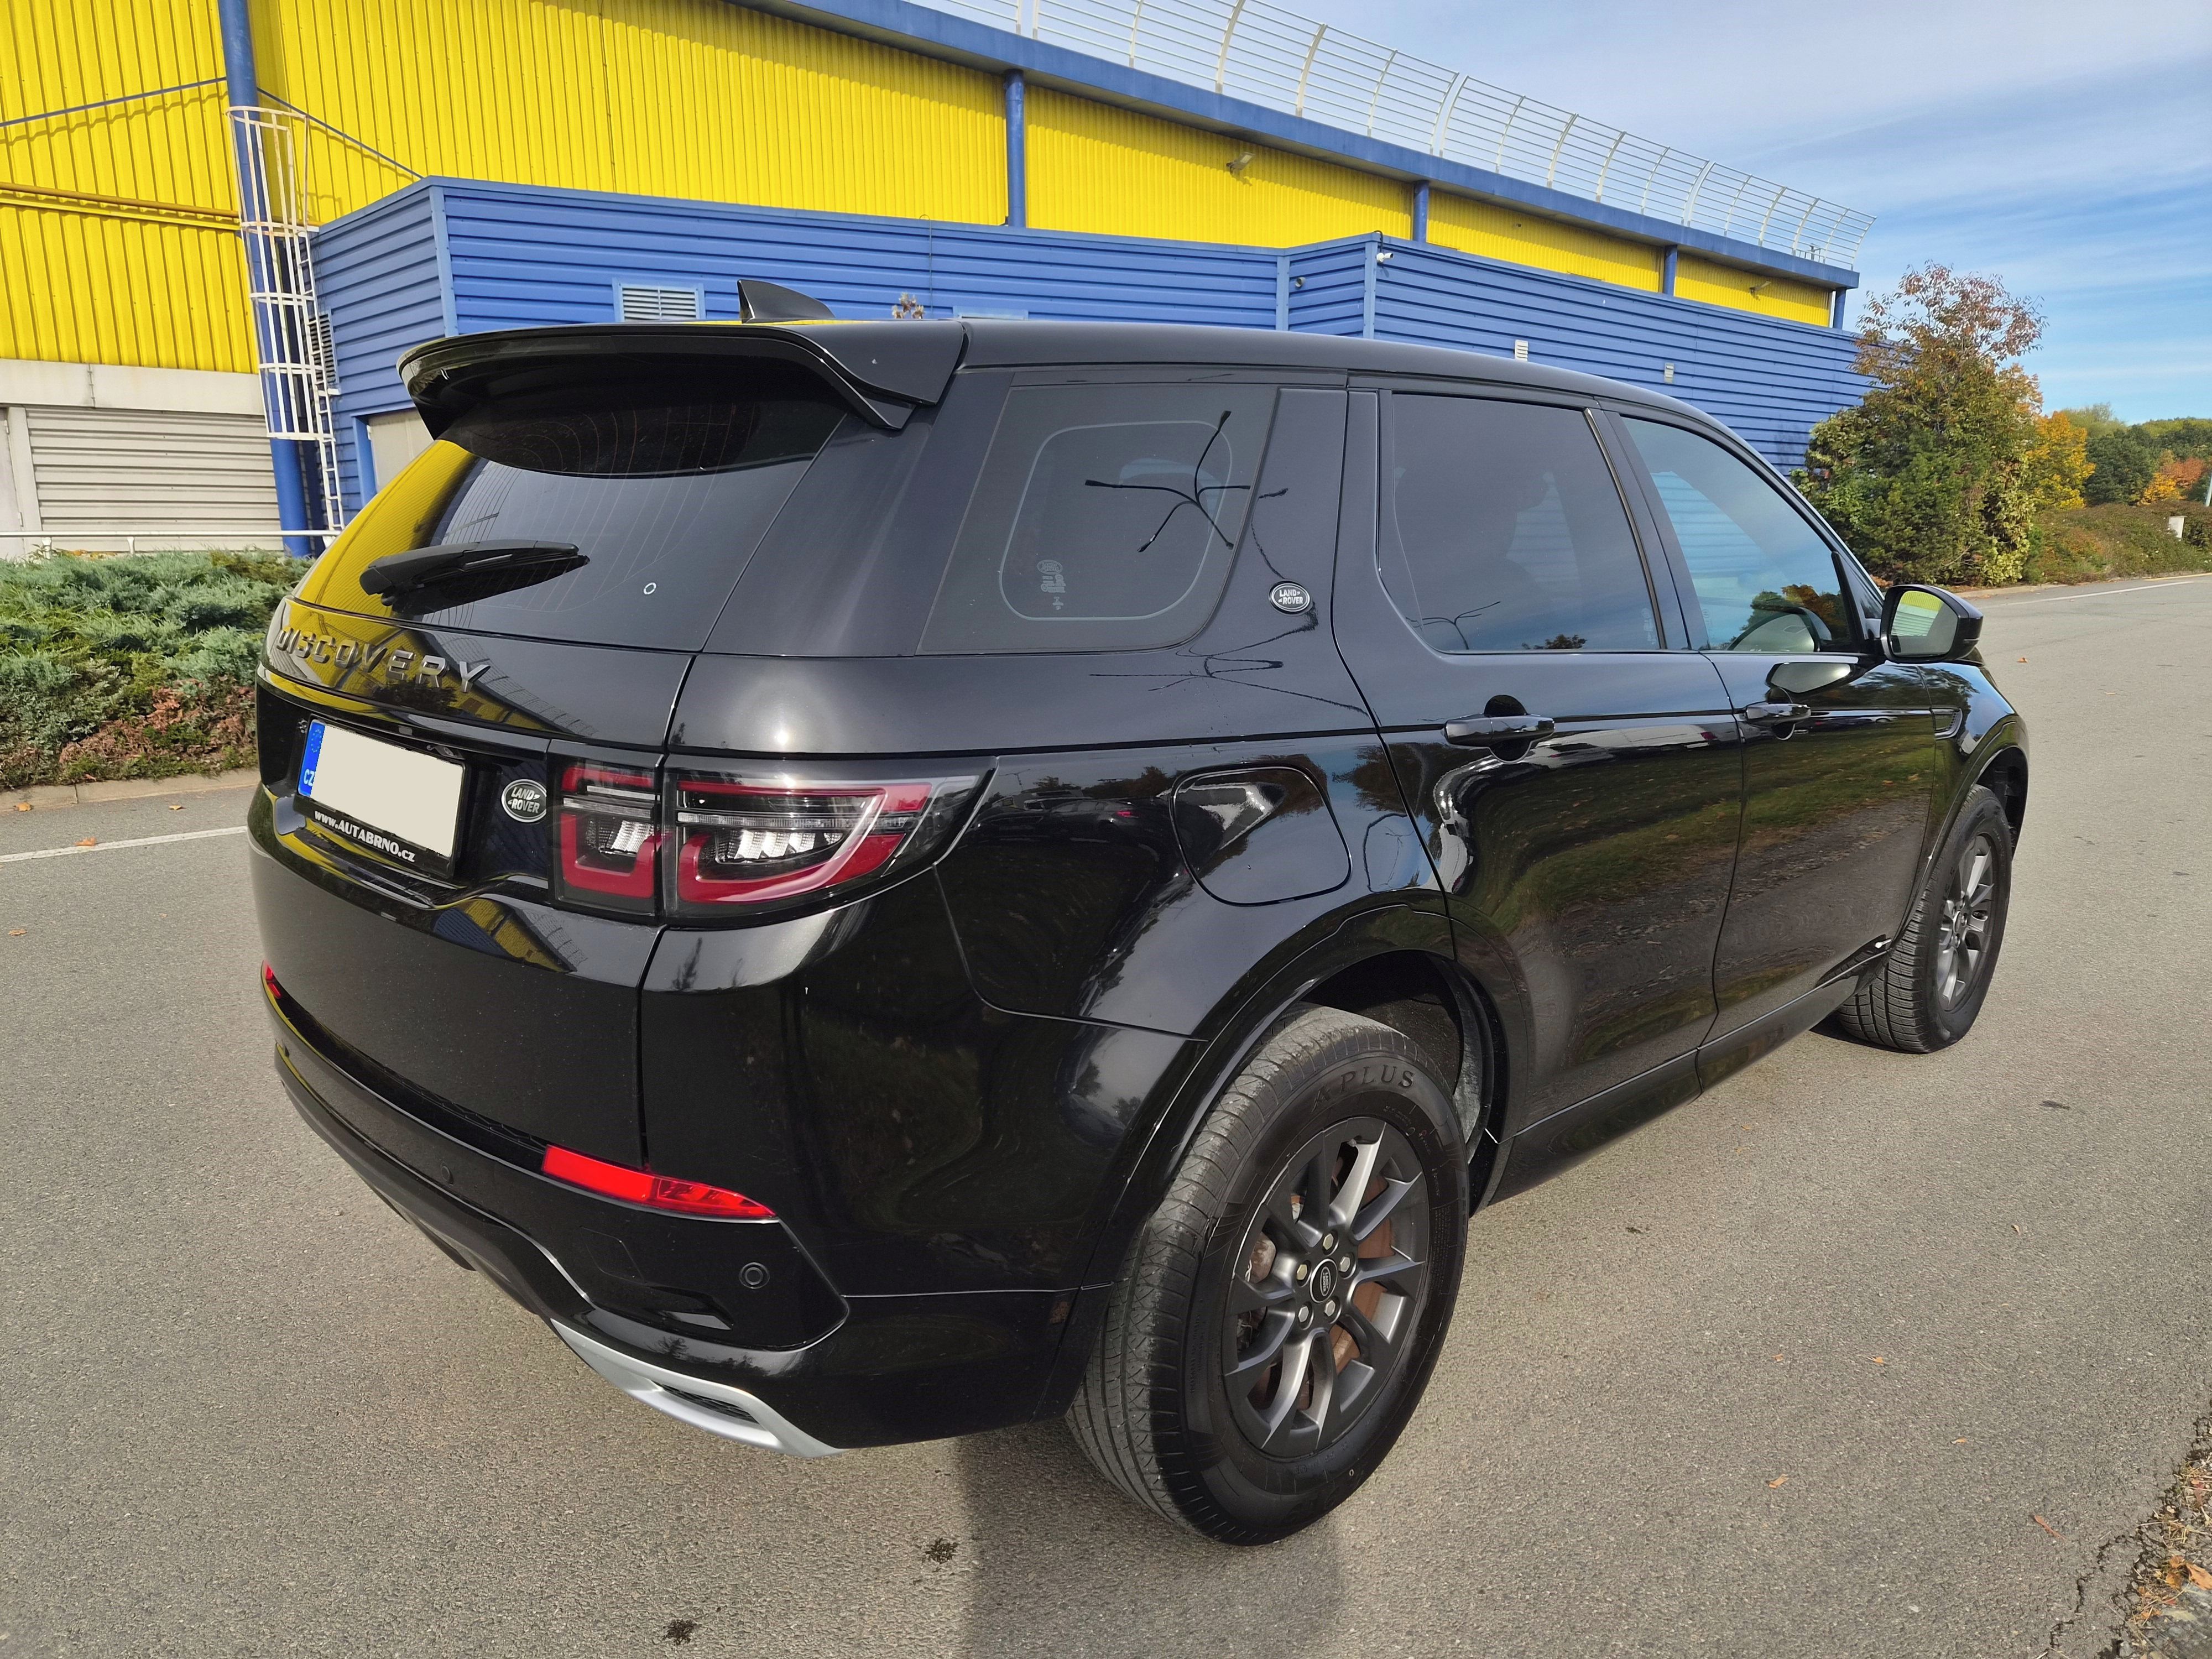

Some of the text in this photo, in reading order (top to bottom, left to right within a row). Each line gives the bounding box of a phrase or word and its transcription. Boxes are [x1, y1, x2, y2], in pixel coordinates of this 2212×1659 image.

[1279, 589, 1297, 597] LAND
[1282, 596, 1303, 604] ROVER
[276, 625, 491, 693] DISCOVERY
[304, 769, 315, 786] CZ
[511, 786, 535, 800] LAND
[511, 798, 540, 813] ROVER
[315, 810, 415, 863] www.AUTABRNO.cz
